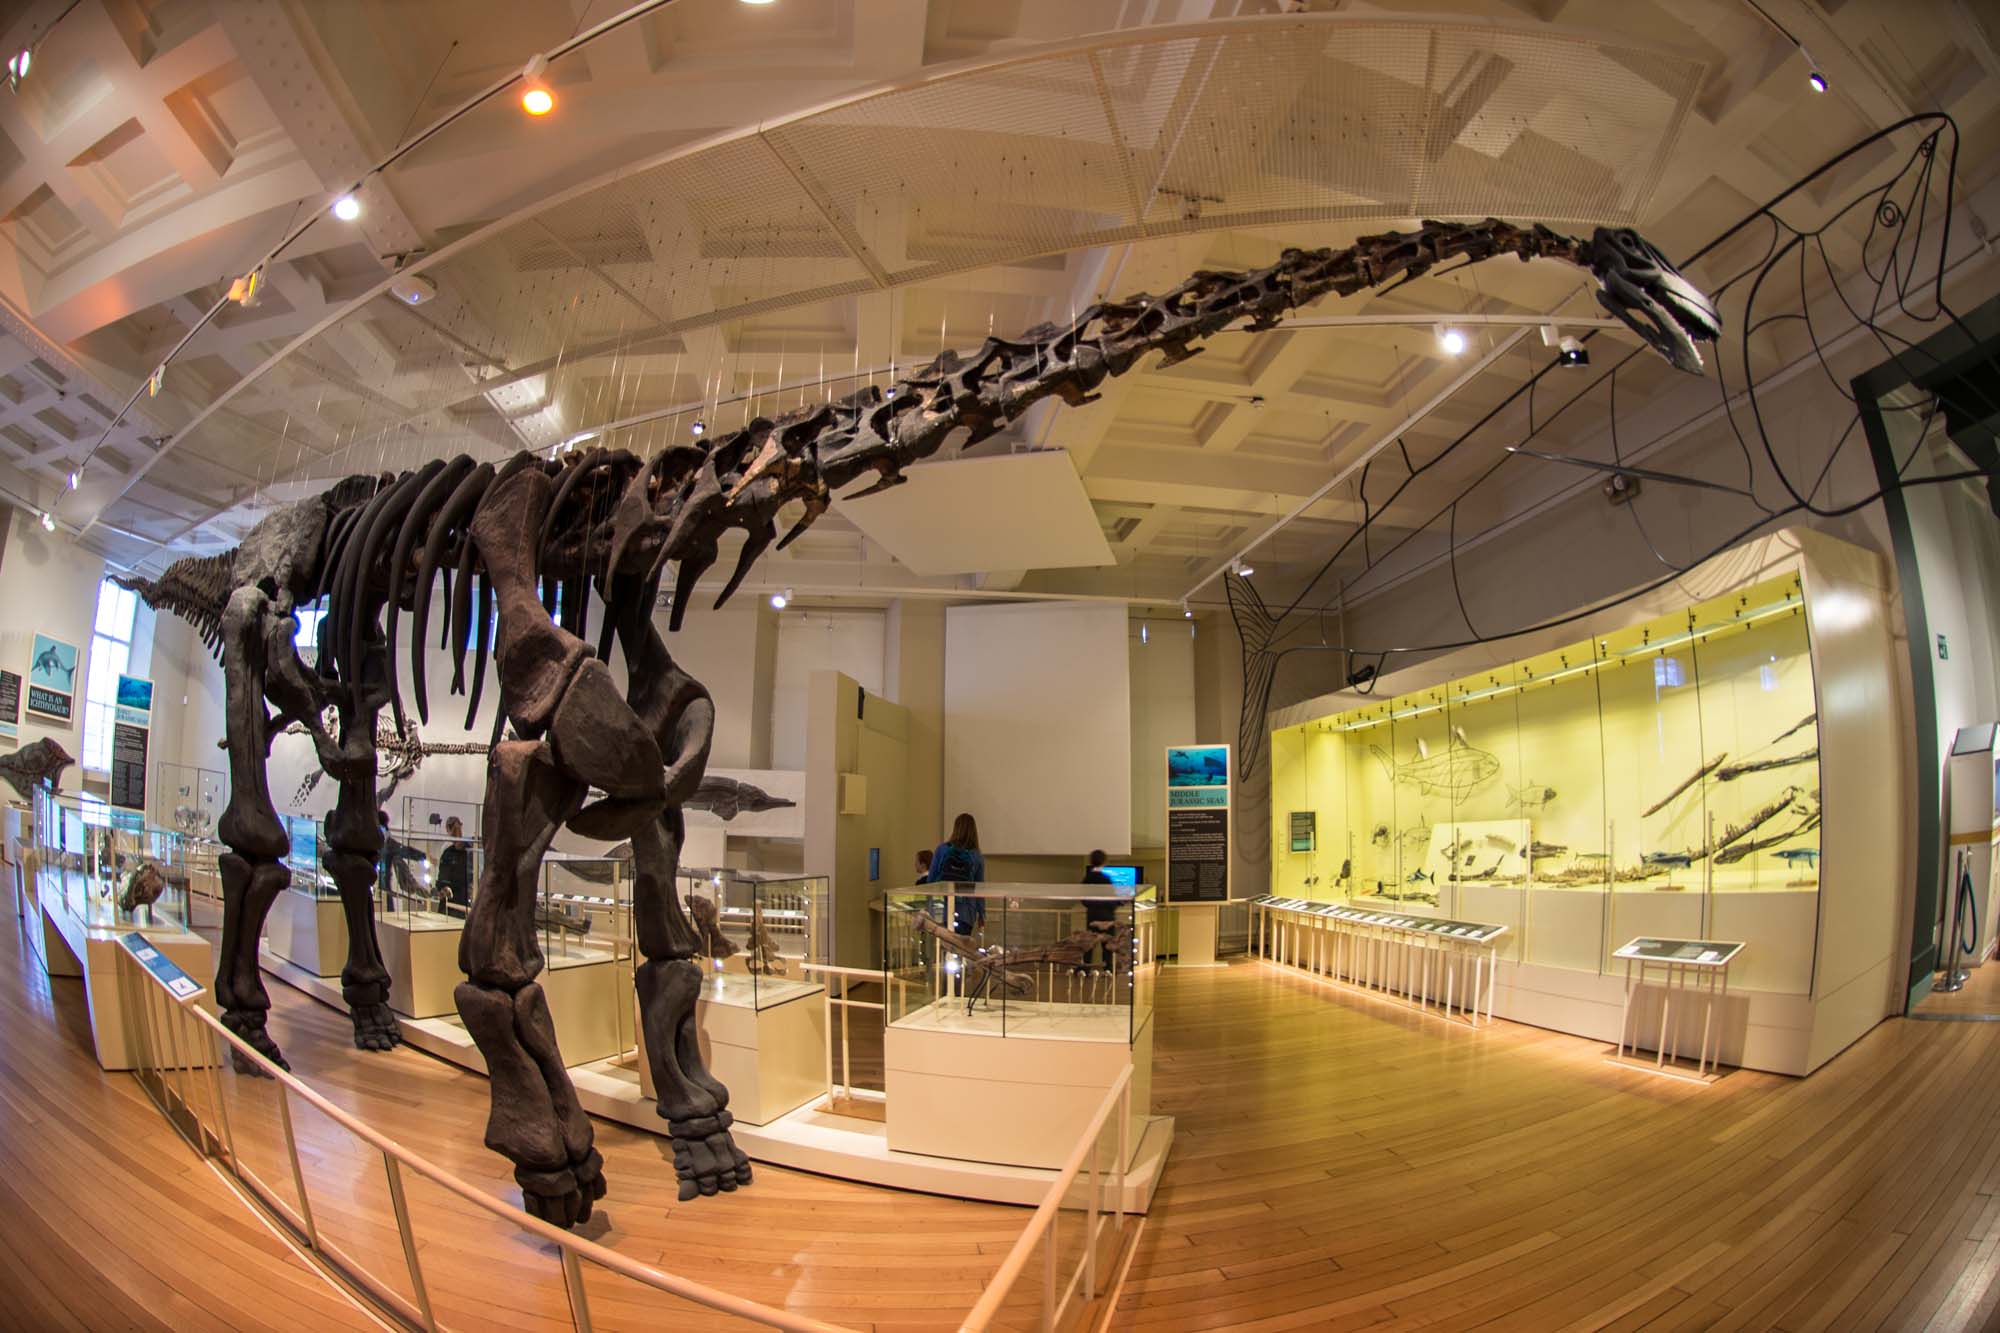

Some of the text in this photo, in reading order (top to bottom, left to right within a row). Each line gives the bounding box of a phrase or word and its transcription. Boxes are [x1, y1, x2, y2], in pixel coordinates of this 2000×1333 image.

[31, 689, 48, 701] WHAT
[54, 694, 63, 705] AN
[1170, 789, 1200, 798] MIDDLE
[1169, 796, 1225, 807] JURASSIC SEAS
